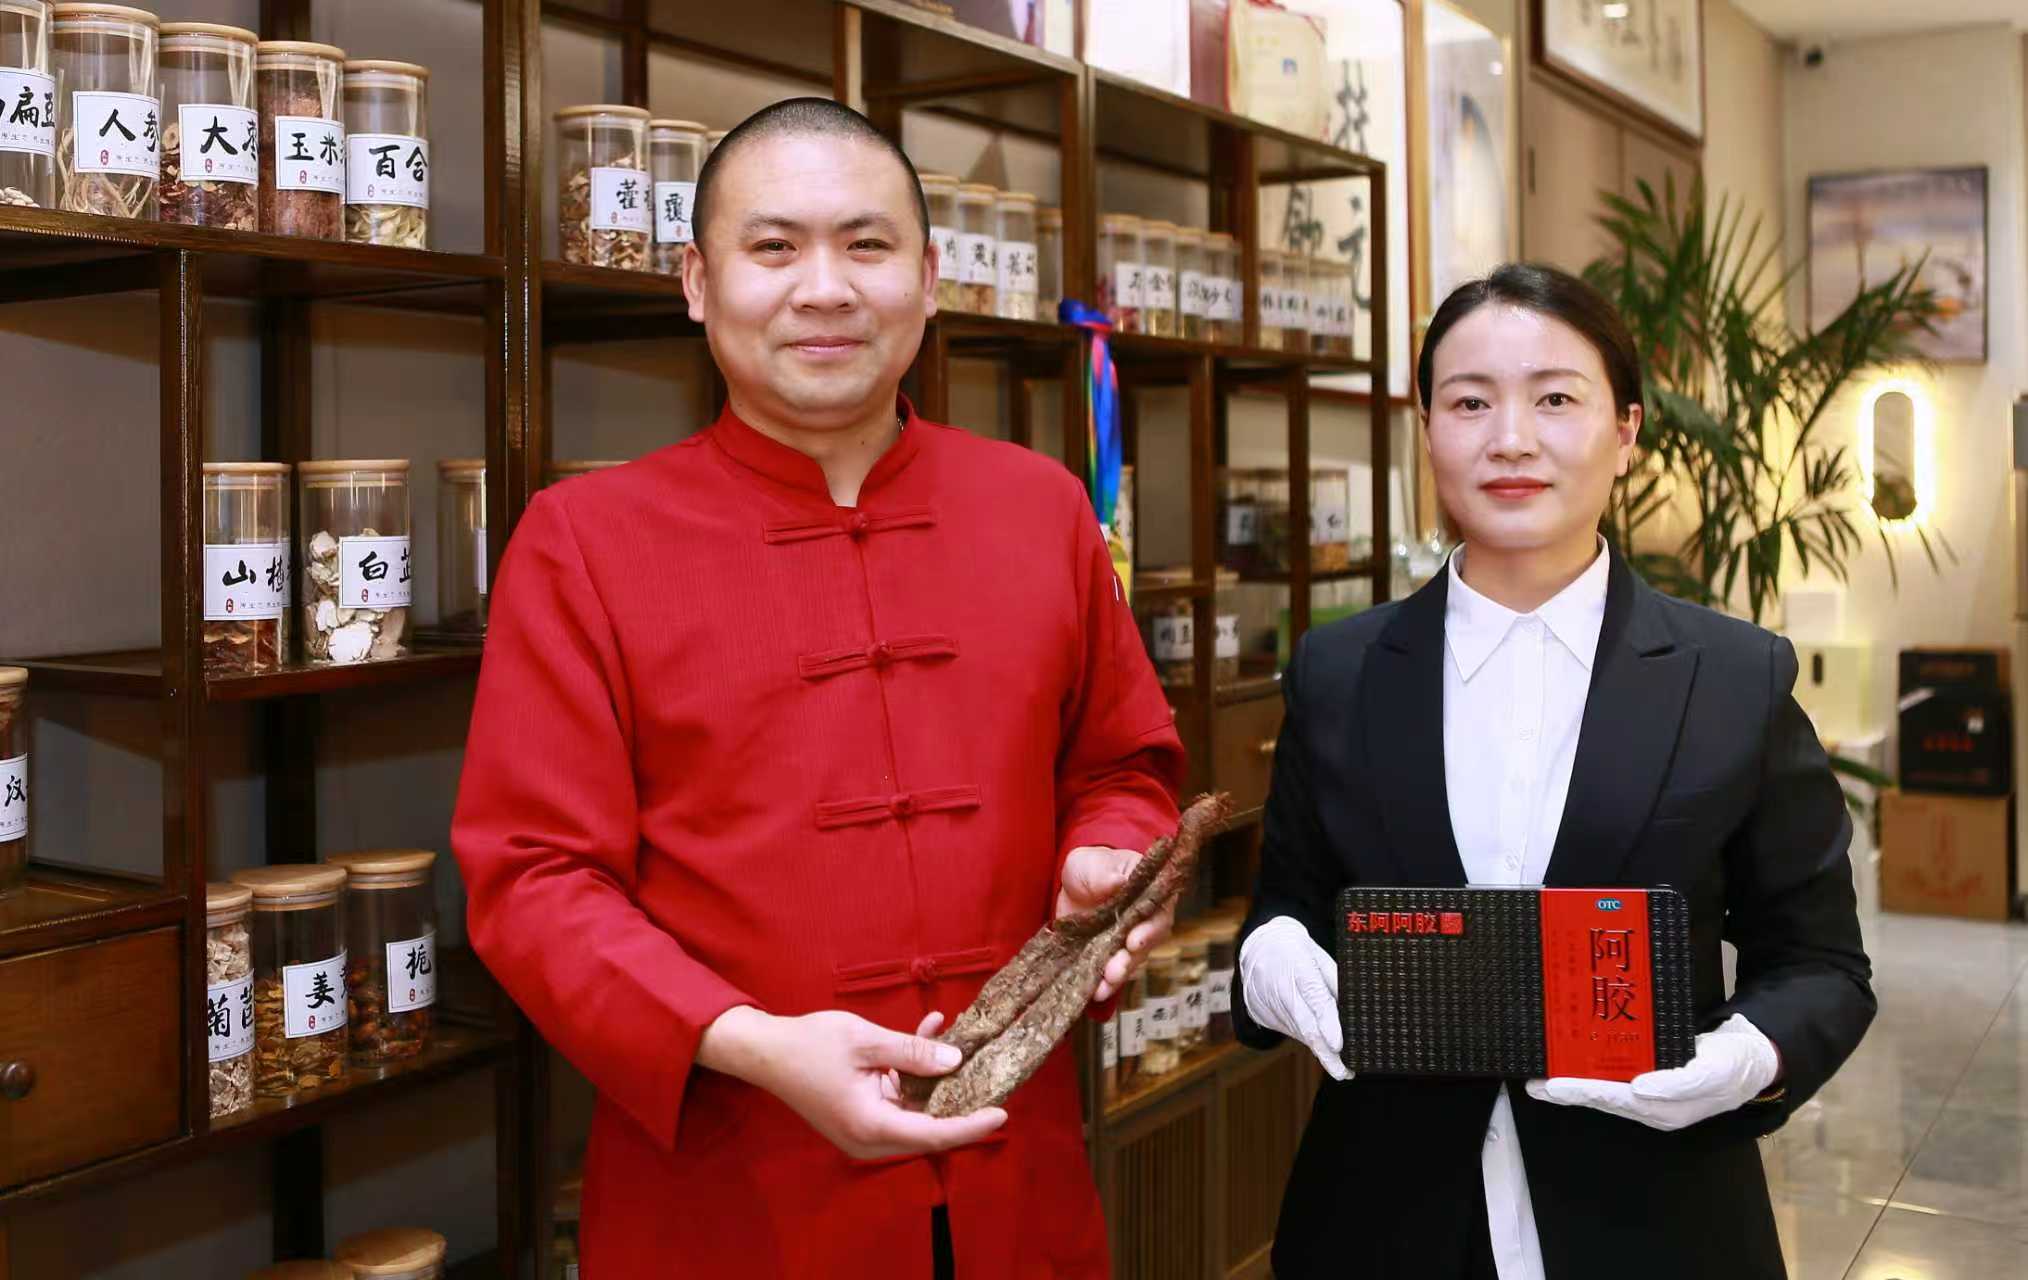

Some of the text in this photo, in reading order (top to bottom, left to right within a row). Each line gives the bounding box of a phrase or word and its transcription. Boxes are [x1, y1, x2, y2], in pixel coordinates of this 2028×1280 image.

[0, 86, 55, 130] 扁豆
[369, 143, 428, 183] 百合
[222, 556, 284, 594] 山楂
[1347, 911, 1437, 934] 东阿阿胶
[1597, 900, 1621, 910] OTC
[1589, 927, 1640, 1023] 阿胶
